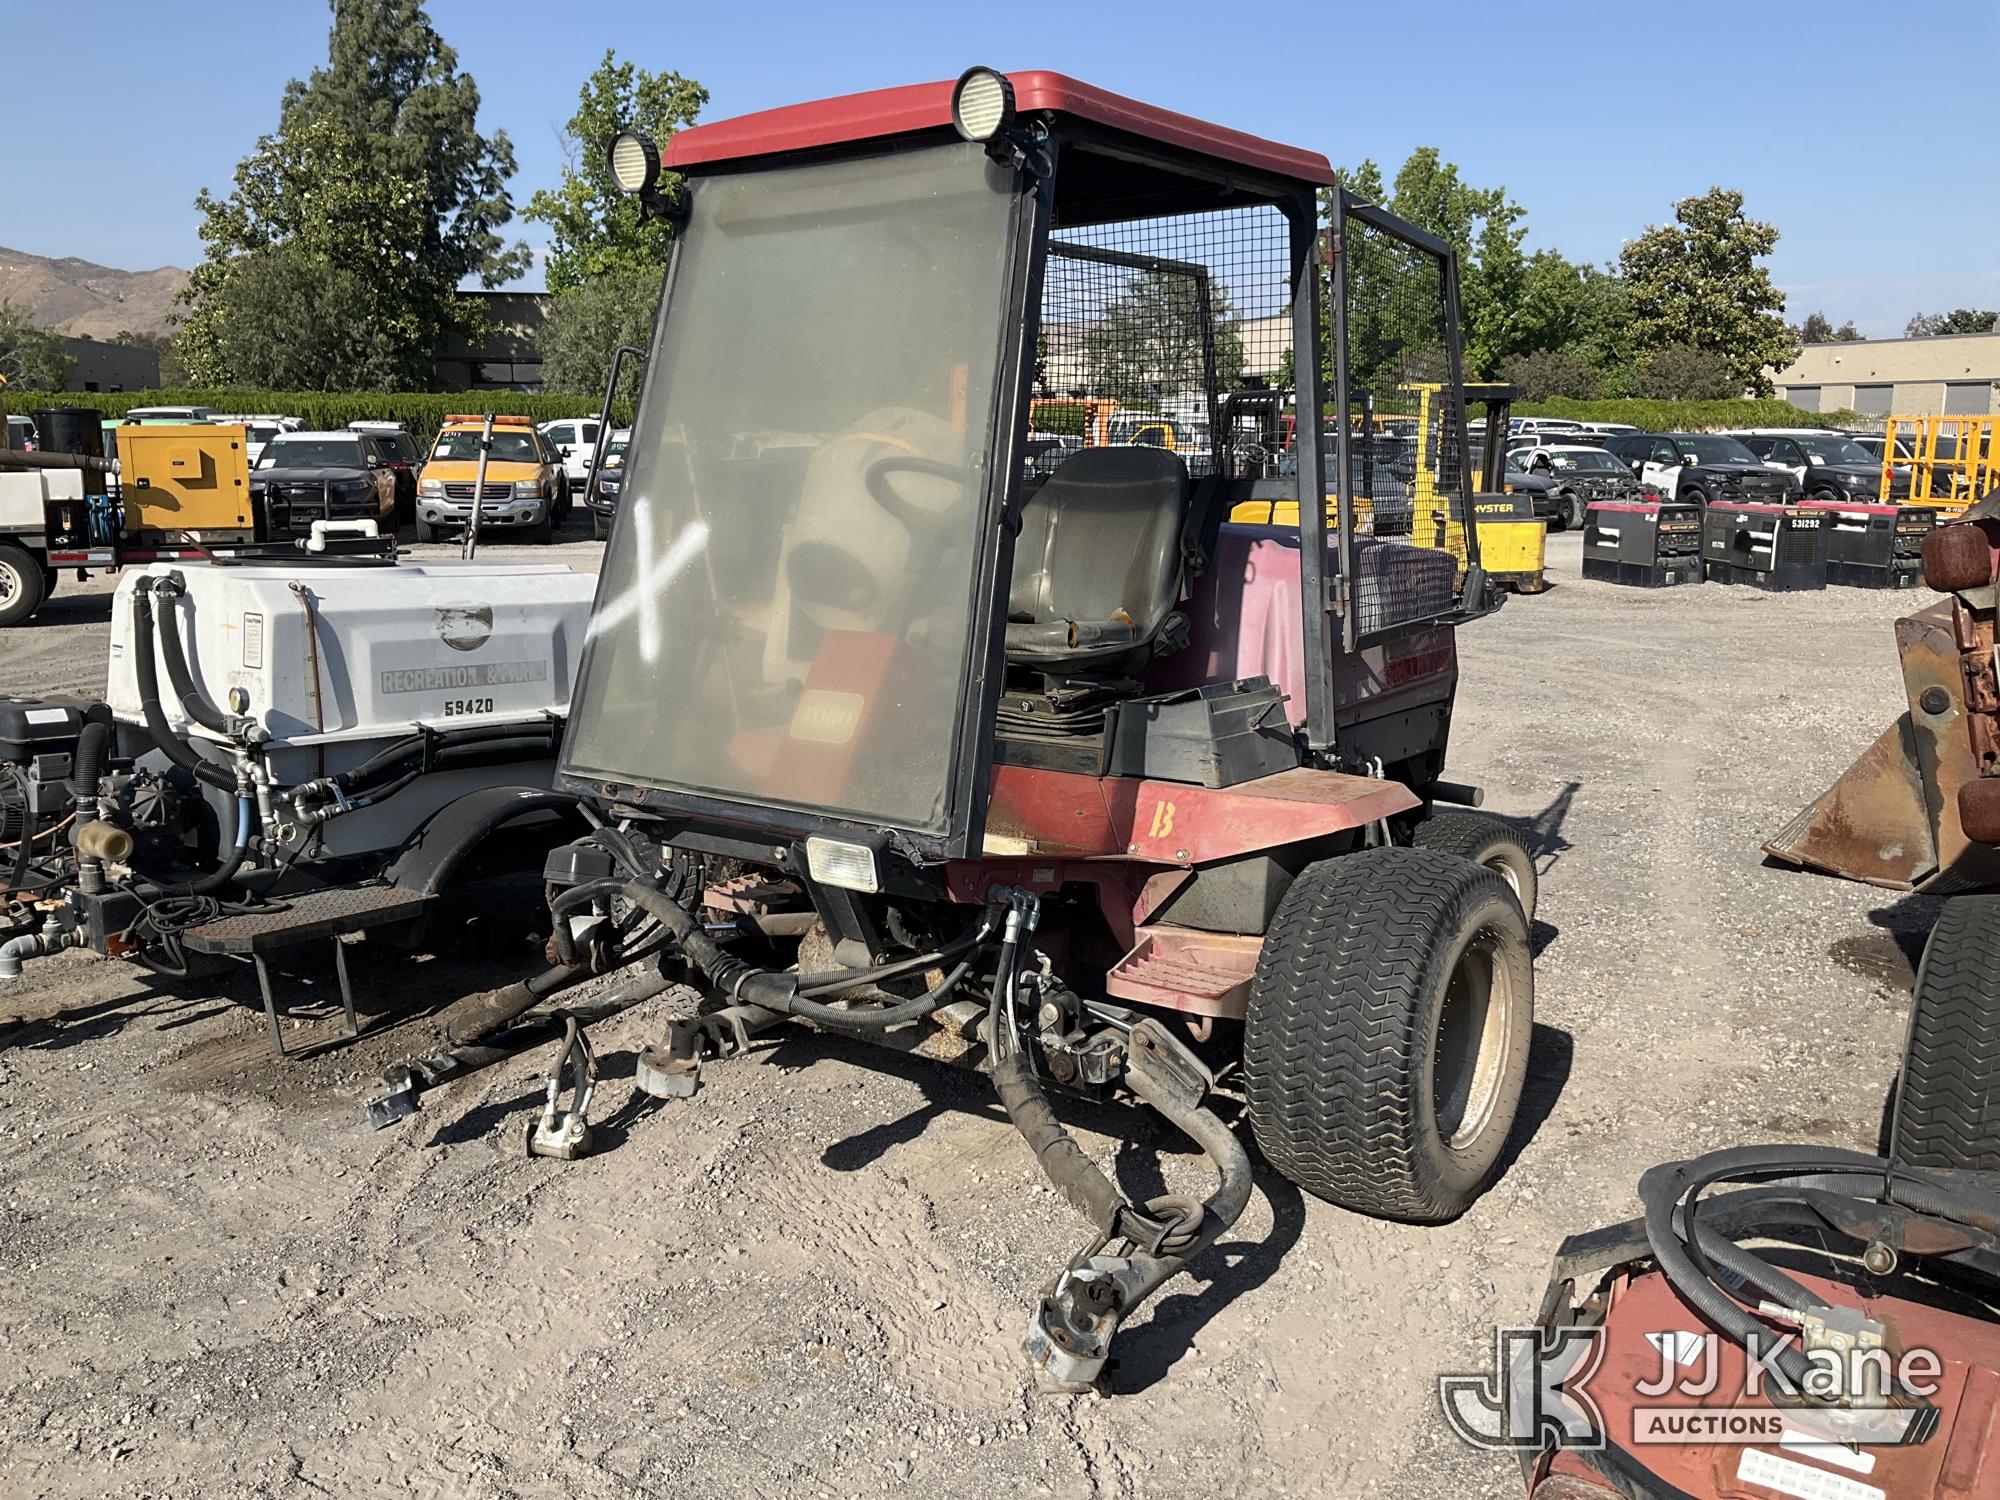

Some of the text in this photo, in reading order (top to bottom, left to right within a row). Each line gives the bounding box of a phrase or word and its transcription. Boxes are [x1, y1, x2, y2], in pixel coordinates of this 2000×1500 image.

[1791, 519, 1820, 528] 531292
[383, 666, 478, 692] RECREATION
[445, 698, 493, 716] 59420
[1149, 800, 1175, 838] B
